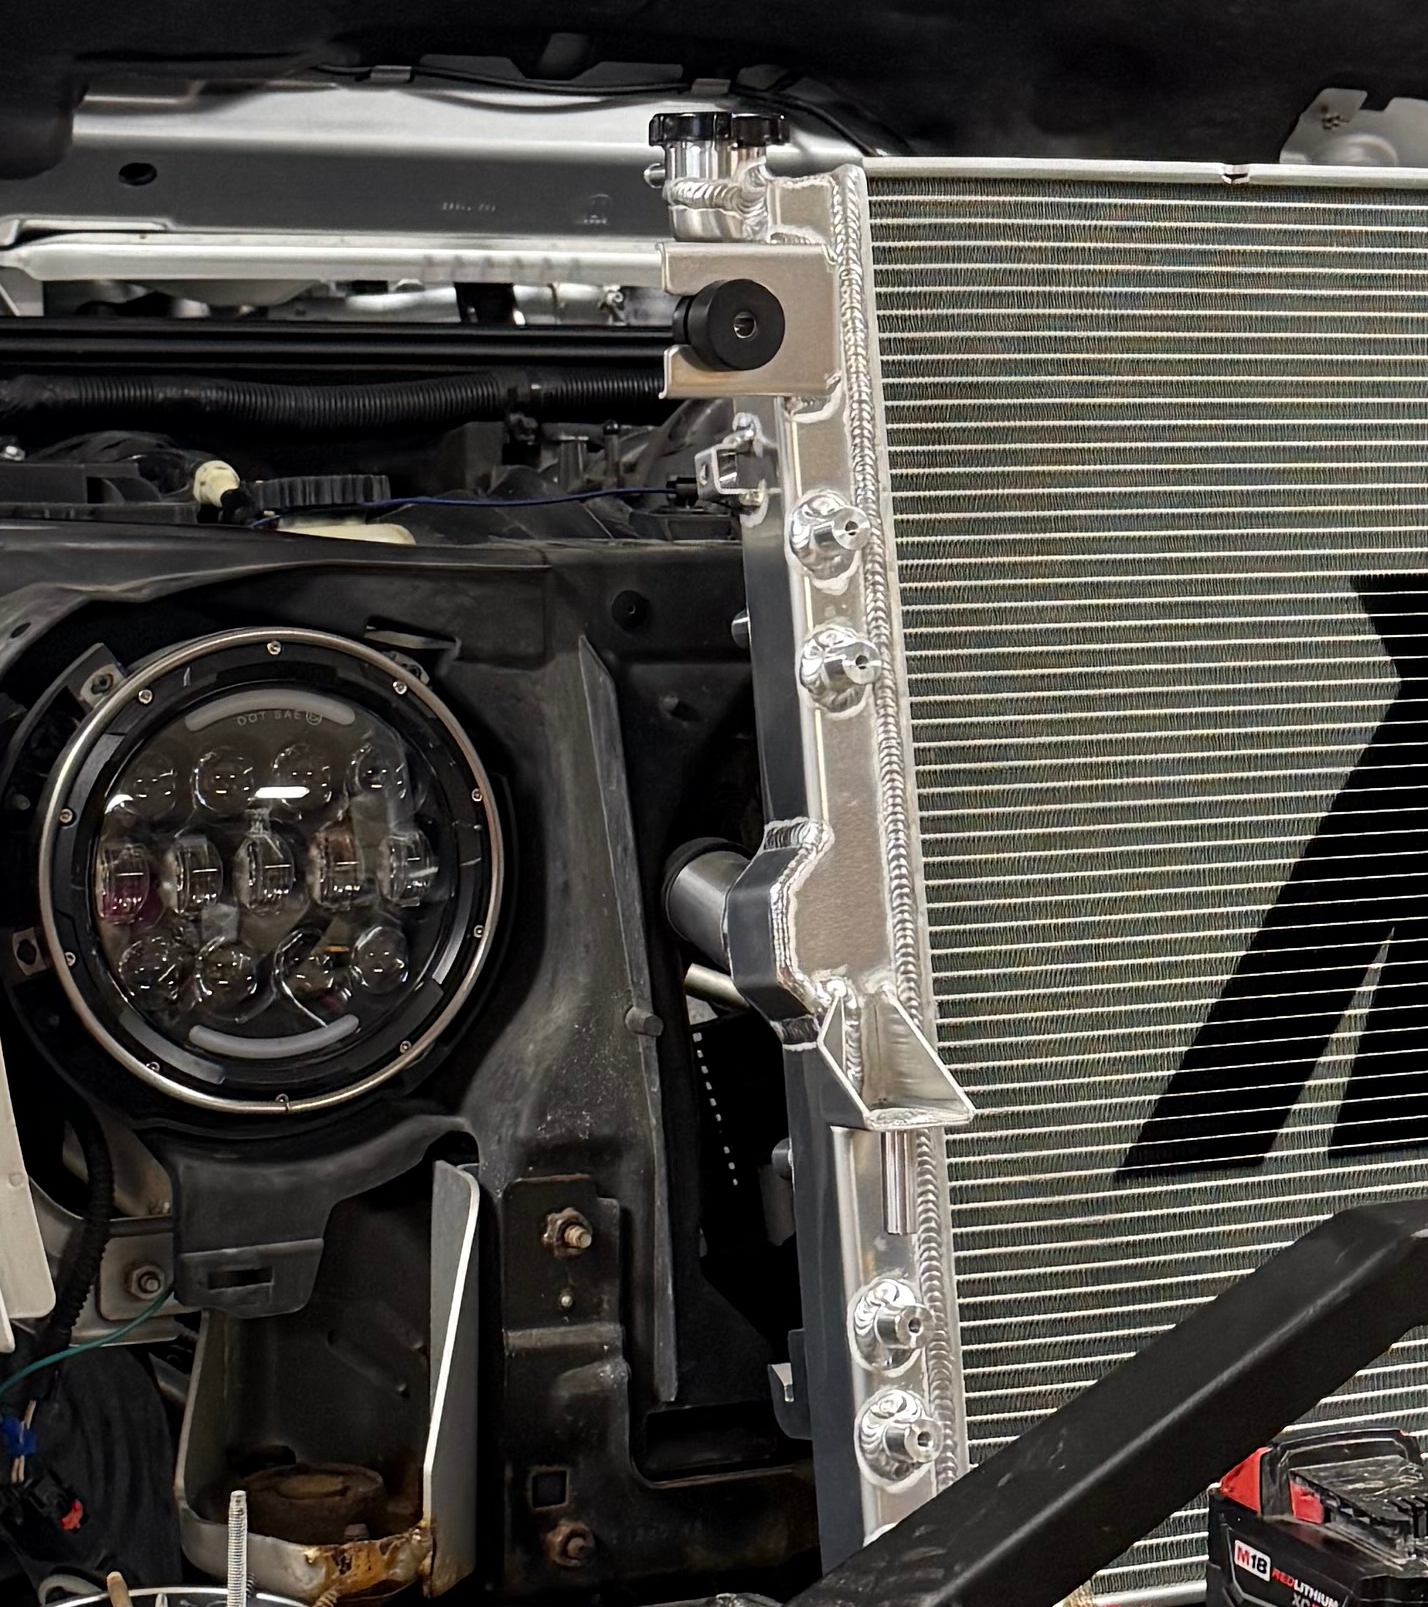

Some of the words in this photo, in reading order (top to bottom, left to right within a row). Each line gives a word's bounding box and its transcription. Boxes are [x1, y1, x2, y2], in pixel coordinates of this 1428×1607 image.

[236, 712, 266, 727] DOT
[274, 709, 303, 720] SAE
[1236, 1545, 1268, 1575] M18
